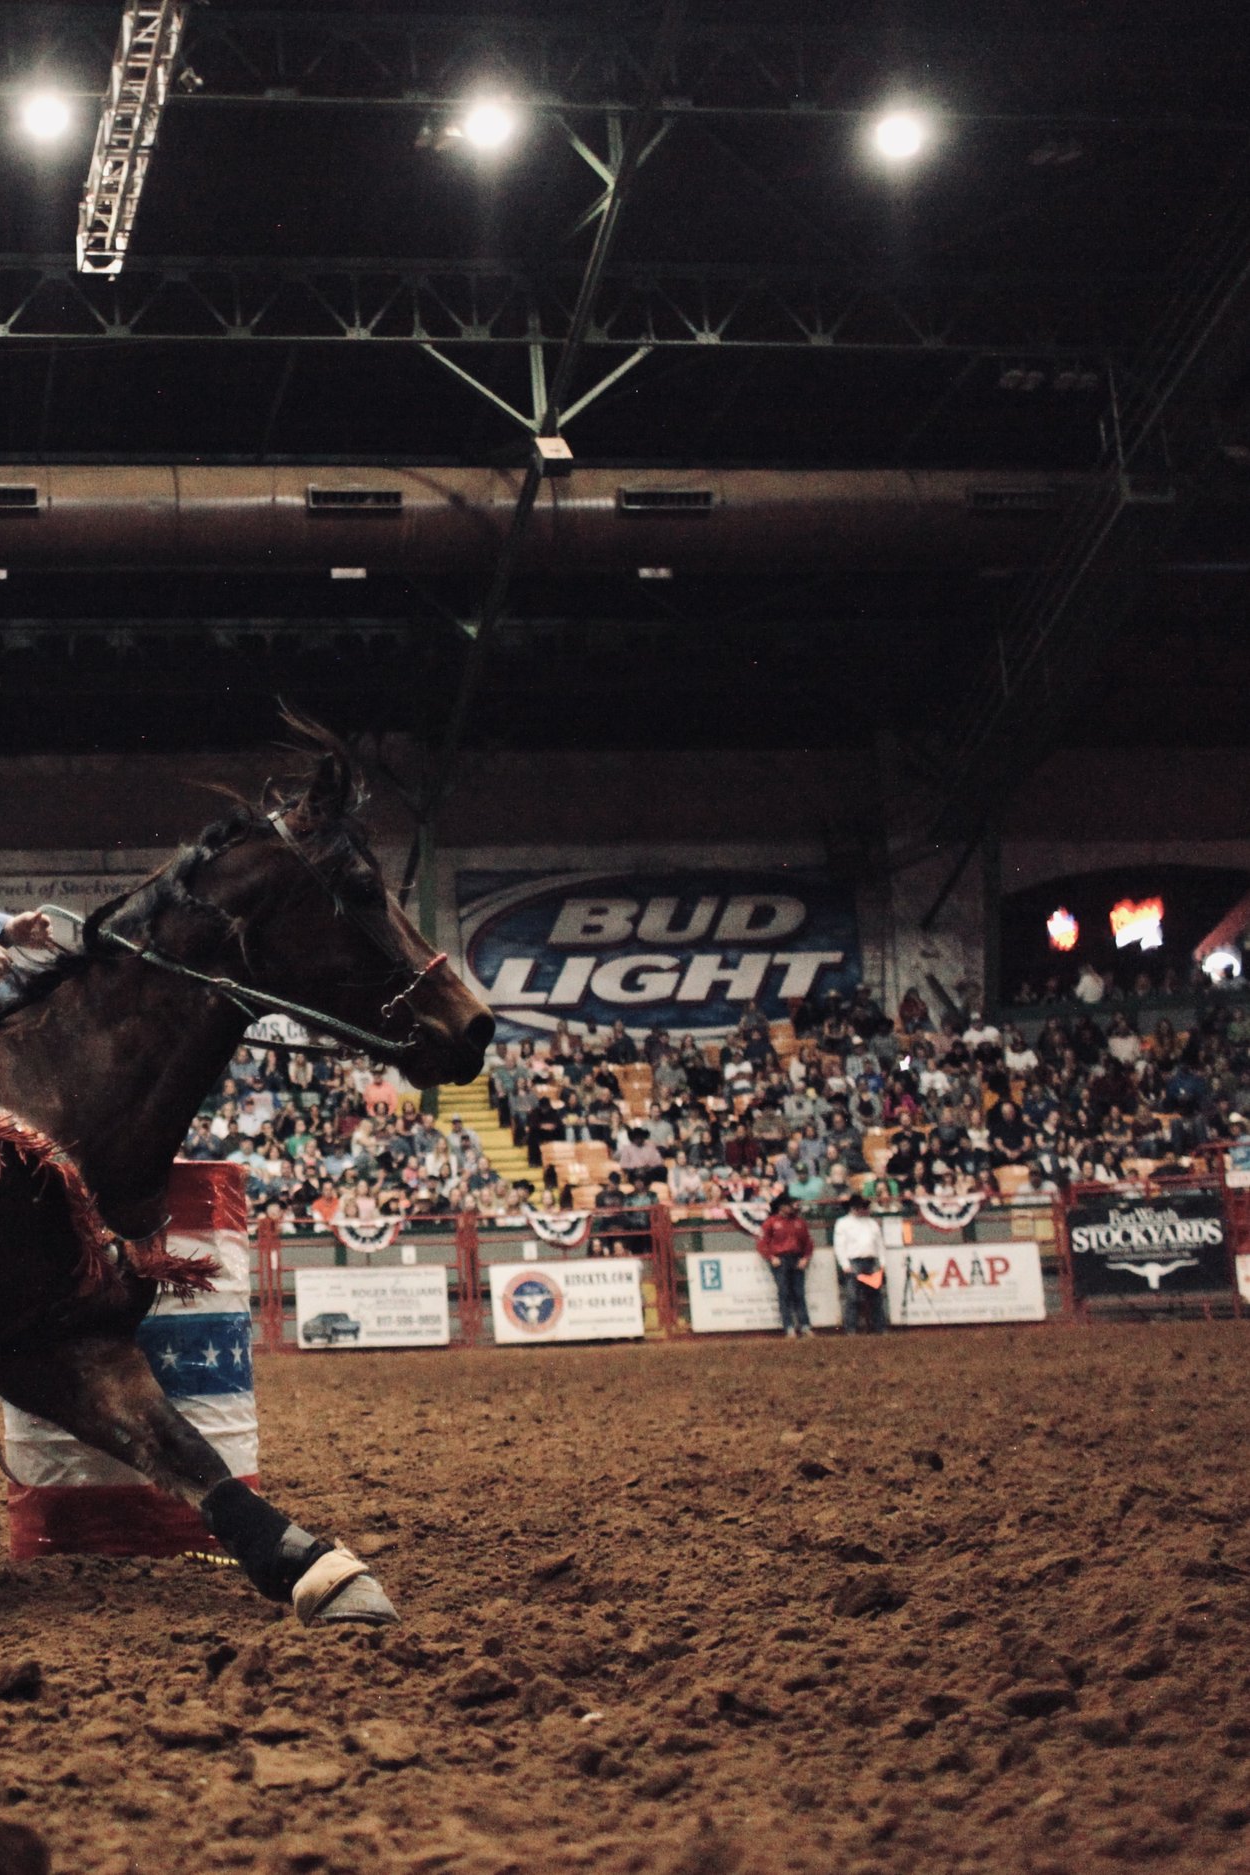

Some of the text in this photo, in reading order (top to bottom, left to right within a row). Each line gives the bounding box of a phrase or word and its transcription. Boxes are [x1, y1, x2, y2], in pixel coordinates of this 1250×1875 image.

[39, 881, 55, 898] of
[549, 895, 806, 945] BUD
[485, 951, 843, 1005] LIGHT
[1071, 1217, 1224, 1253] STOCKYARDS
